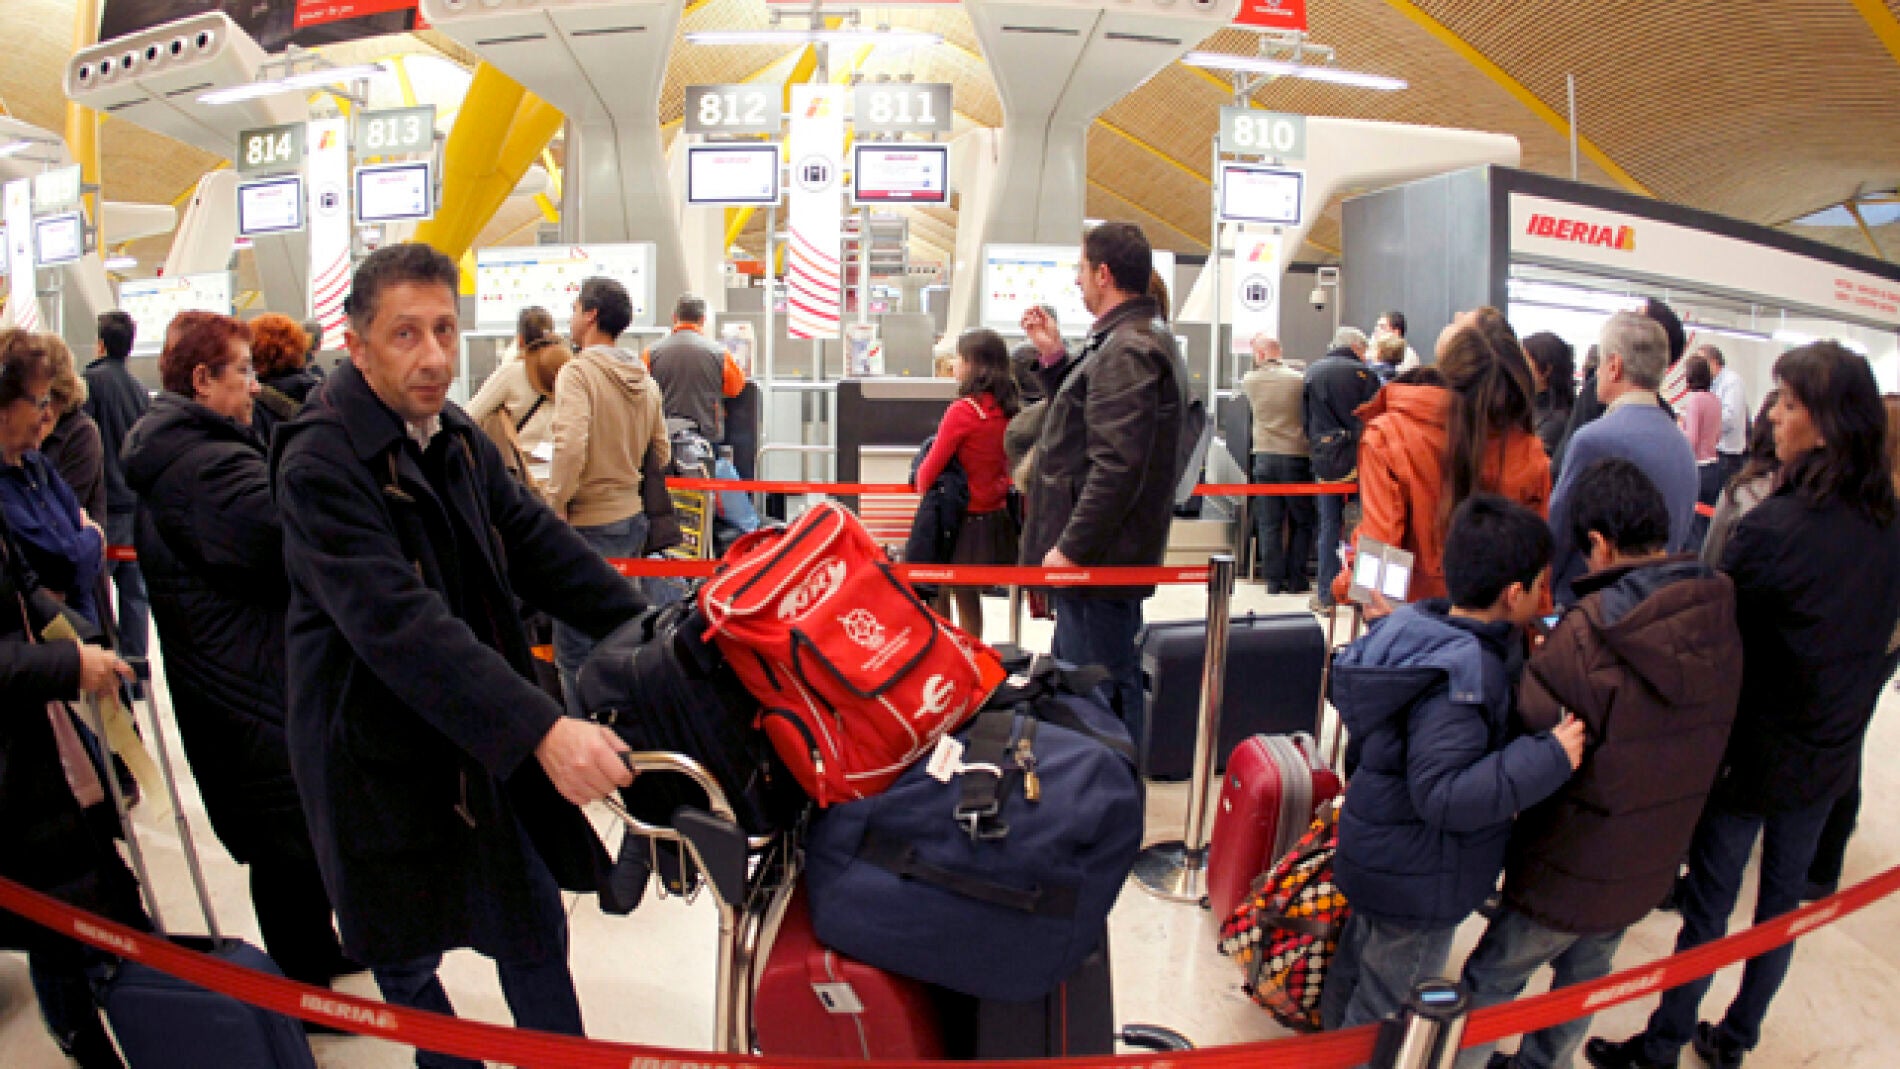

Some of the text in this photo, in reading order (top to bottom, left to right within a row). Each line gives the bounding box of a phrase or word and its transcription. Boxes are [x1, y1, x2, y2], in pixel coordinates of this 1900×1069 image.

[698, 92, 767, 126] 812
[869, 91, 936, 124] 811
[247, 131, 292, 165] 814
[367, 115, 420, 148] 813
[1233, 115, 1295, 151] 810
[1526, 213, 1613, 248] IBERIA
[302, 994, 378, 1027] IBERIA
